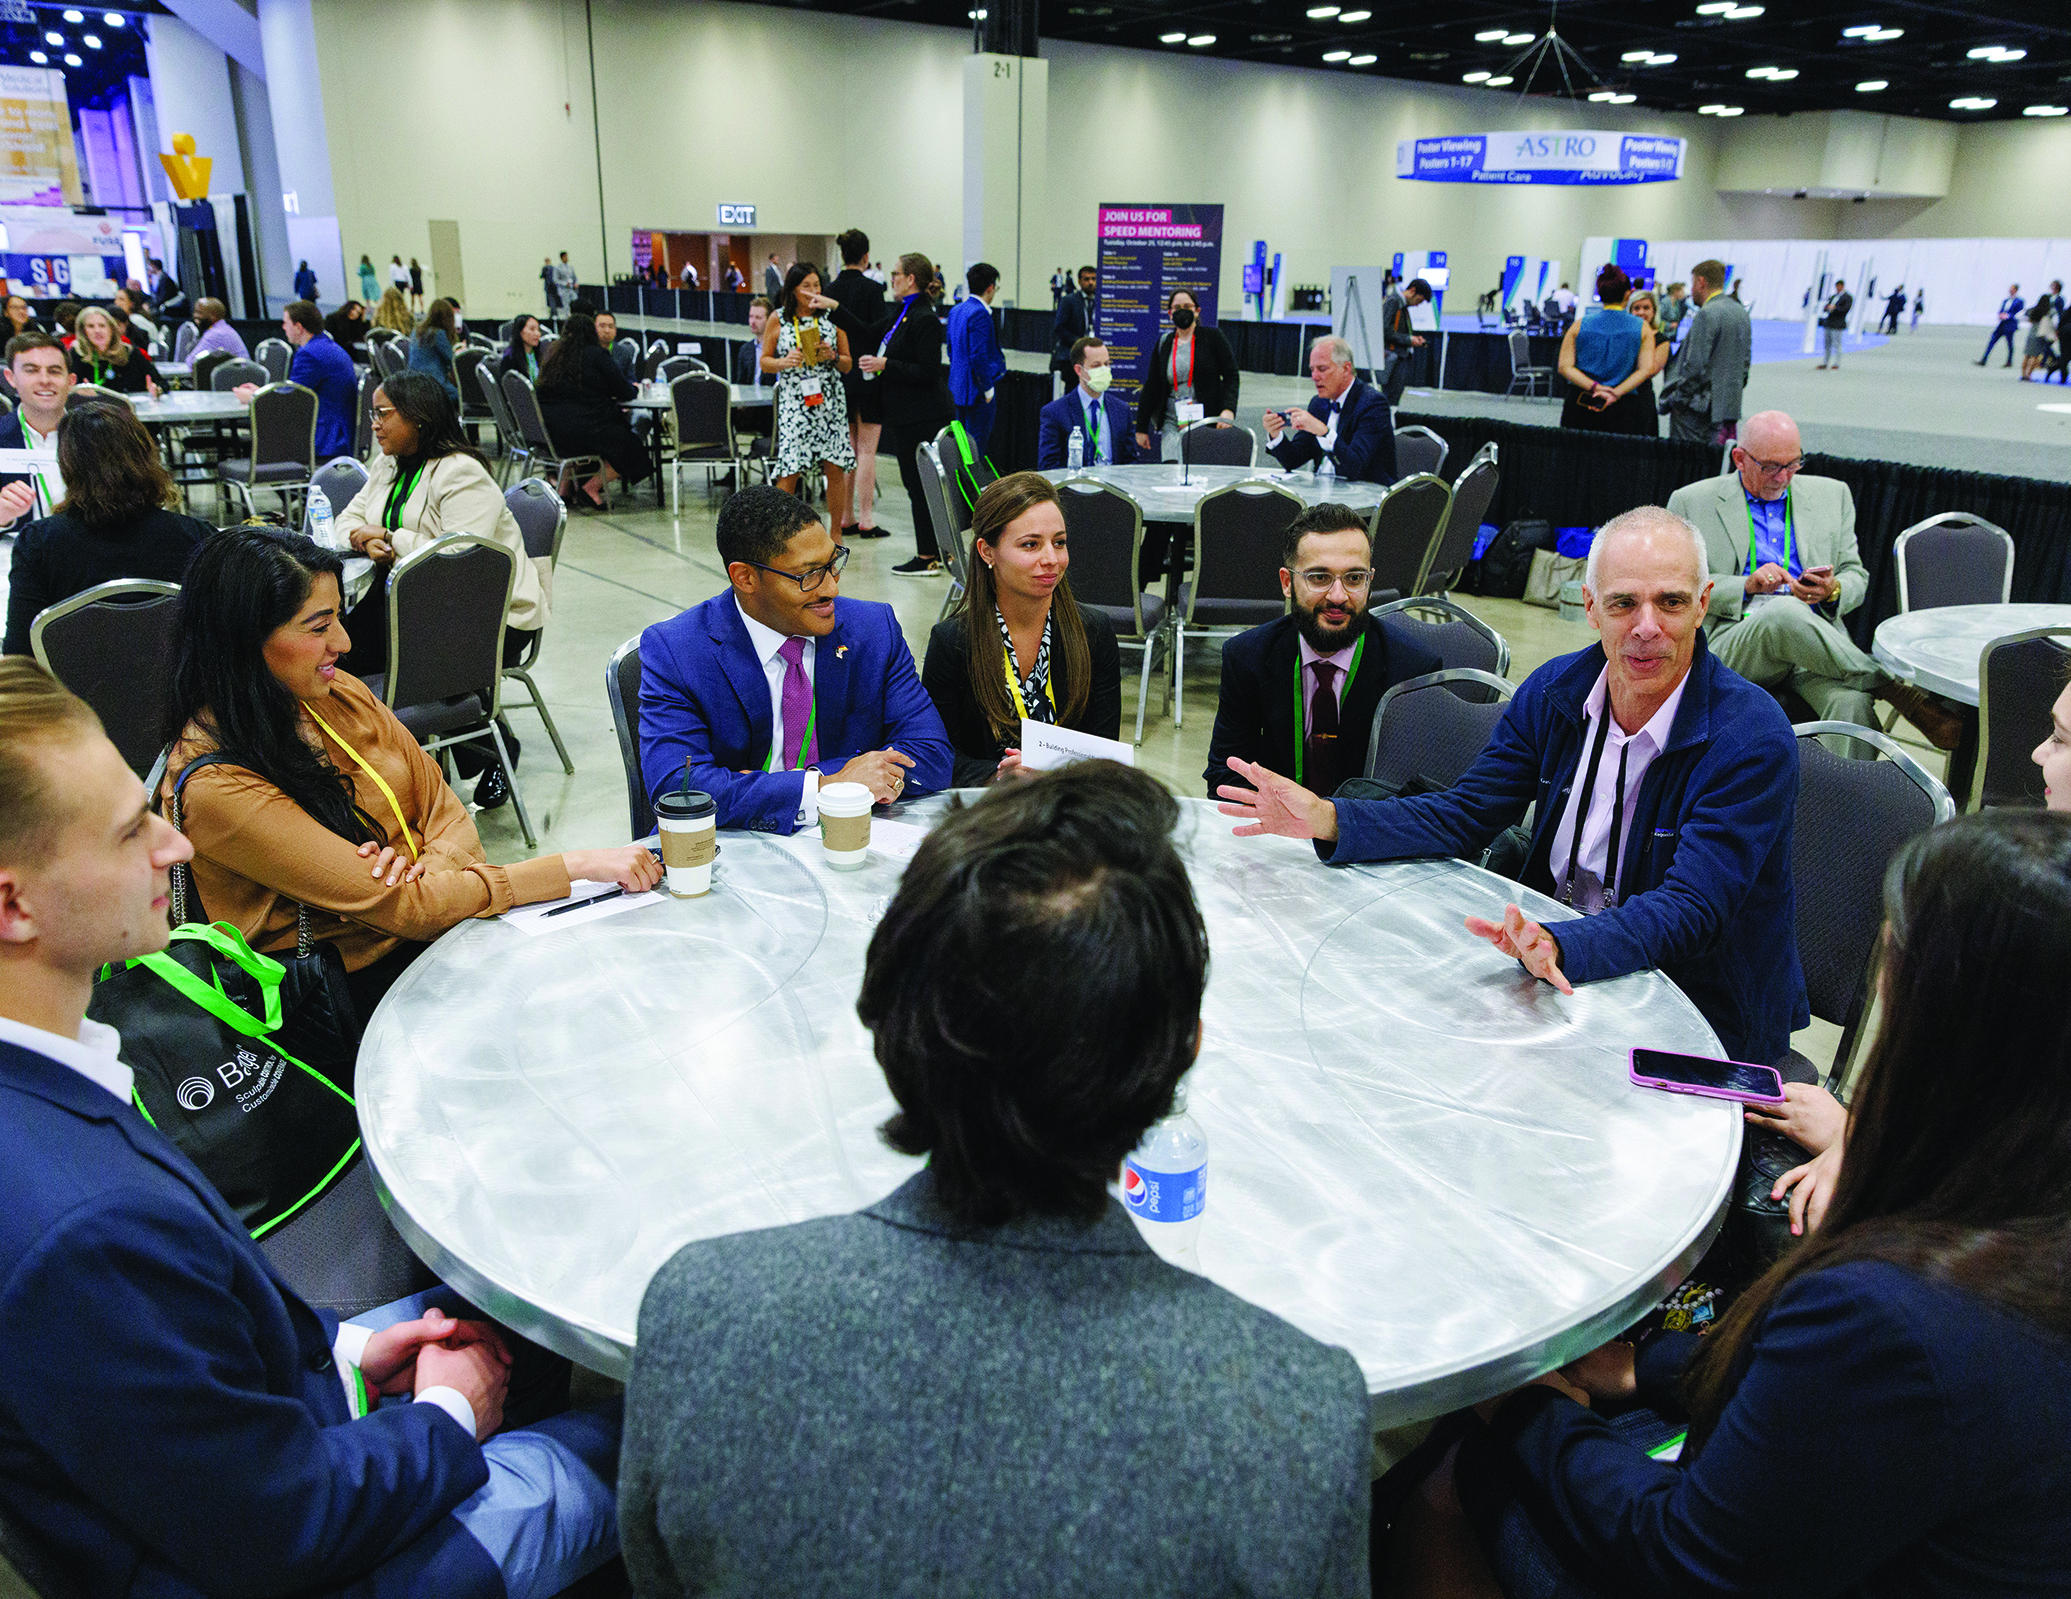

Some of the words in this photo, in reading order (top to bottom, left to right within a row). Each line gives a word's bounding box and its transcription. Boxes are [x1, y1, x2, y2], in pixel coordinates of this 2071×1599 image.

[1442, 138, 1482, 154] Viewing
[1517, 135, 1596, 158] ASTRO
[1472, 169, 1506, 181] Patient
[1507, 171, 1532, 183] Care
[720, 205, 755, 224] EXIT
[1104, 211, 1128, 222] JOIN
[1130, 211, 1144, 222] US
[1146, 211, 1167, 222] FOR
[1104, 226, 1137, 237] SPEED
[1138, 226, 1201, 238] MENTORING
[1046, 742, 1064, 754] Building
[1148, 1180, 1161, 1214] pepsi
